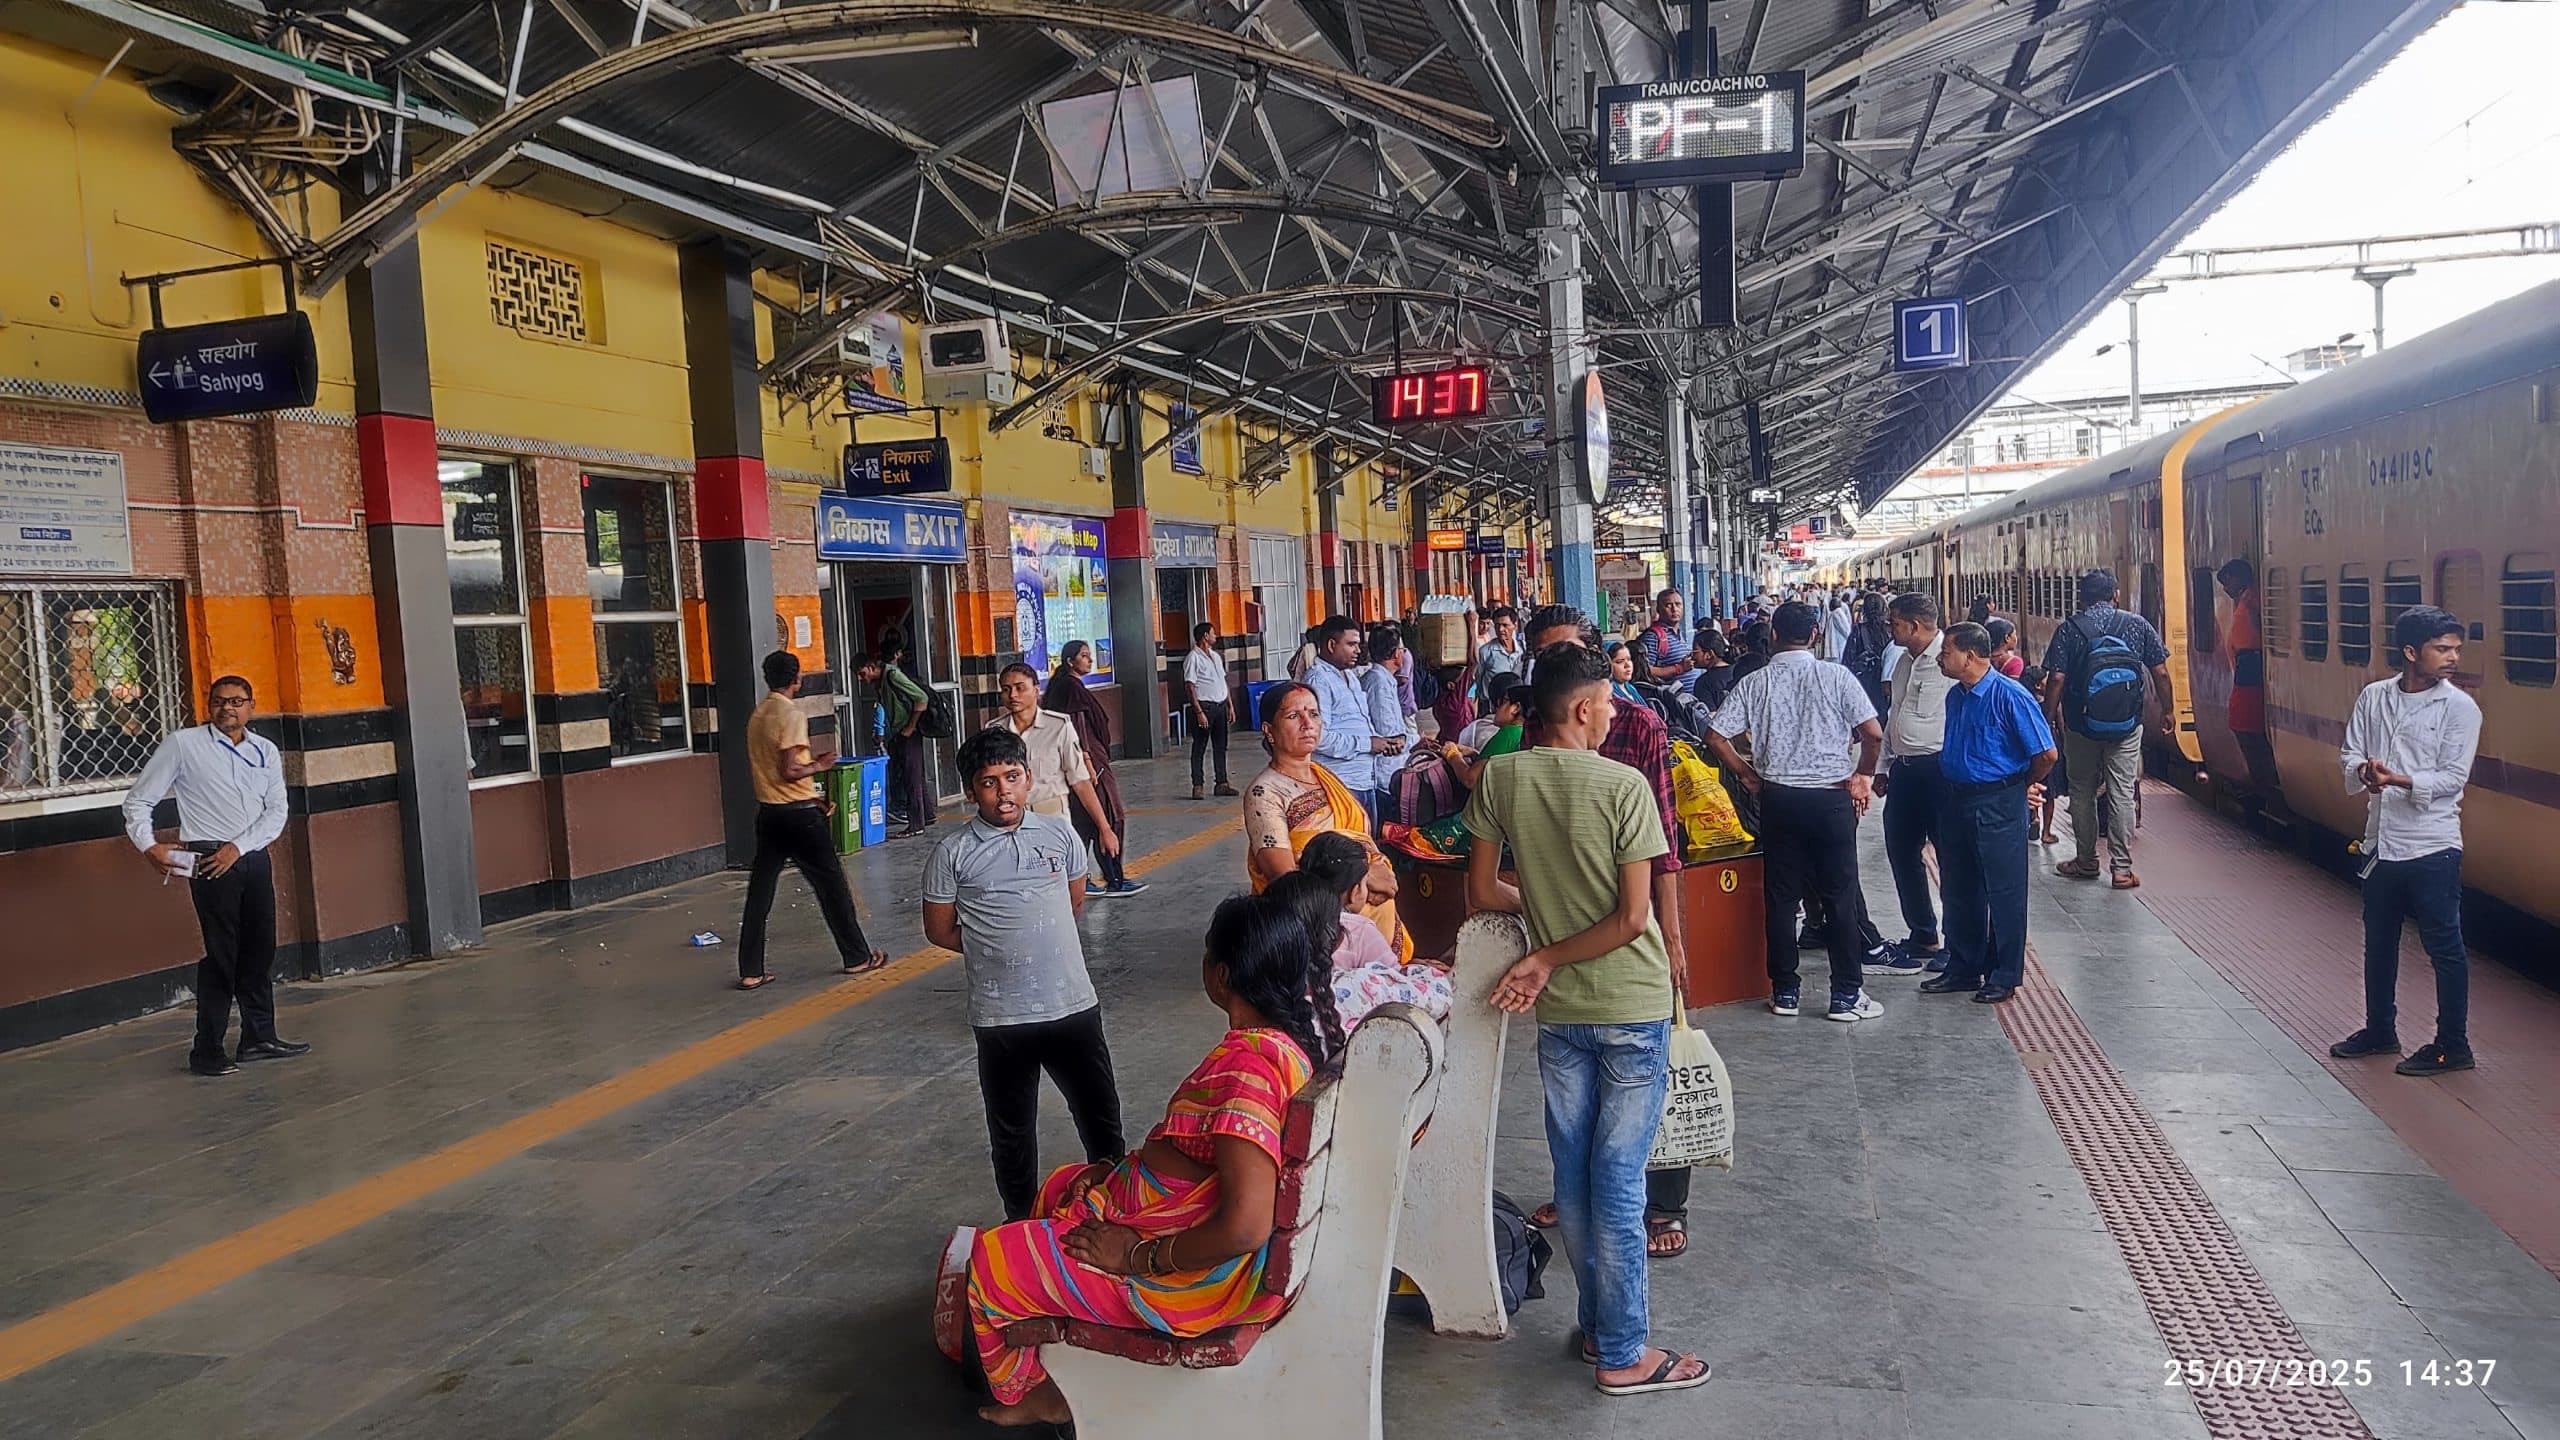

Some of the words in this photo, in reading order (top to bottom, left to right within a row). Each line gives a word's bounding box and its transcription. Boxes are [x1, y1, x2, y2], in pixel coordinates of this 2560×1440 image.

[1642, 77, 1742, 98] TRAIN/COACH
[1744, 75, 1769, 90] NO.
[1632, 92, 1774, 160] PF-1
[1919, 311, 1942, 353] 1
[198, 338, 258, 365] सहयोग
[200, 371, 264, 393] Sahyog
[882, 448, 933, 467] निकास
[882, 470, 911, 484] Exit
[1751, 489, 1782, 503] PF-1
[904, 512, 959, 547] EXIT
[1083, 530, 1099, 551] Map
[1153, 531, 1180, 561] प्रवेश
[1184, 535, 1216, 558] ENTRANCE
[1724, 871, 1733, 890] 8
